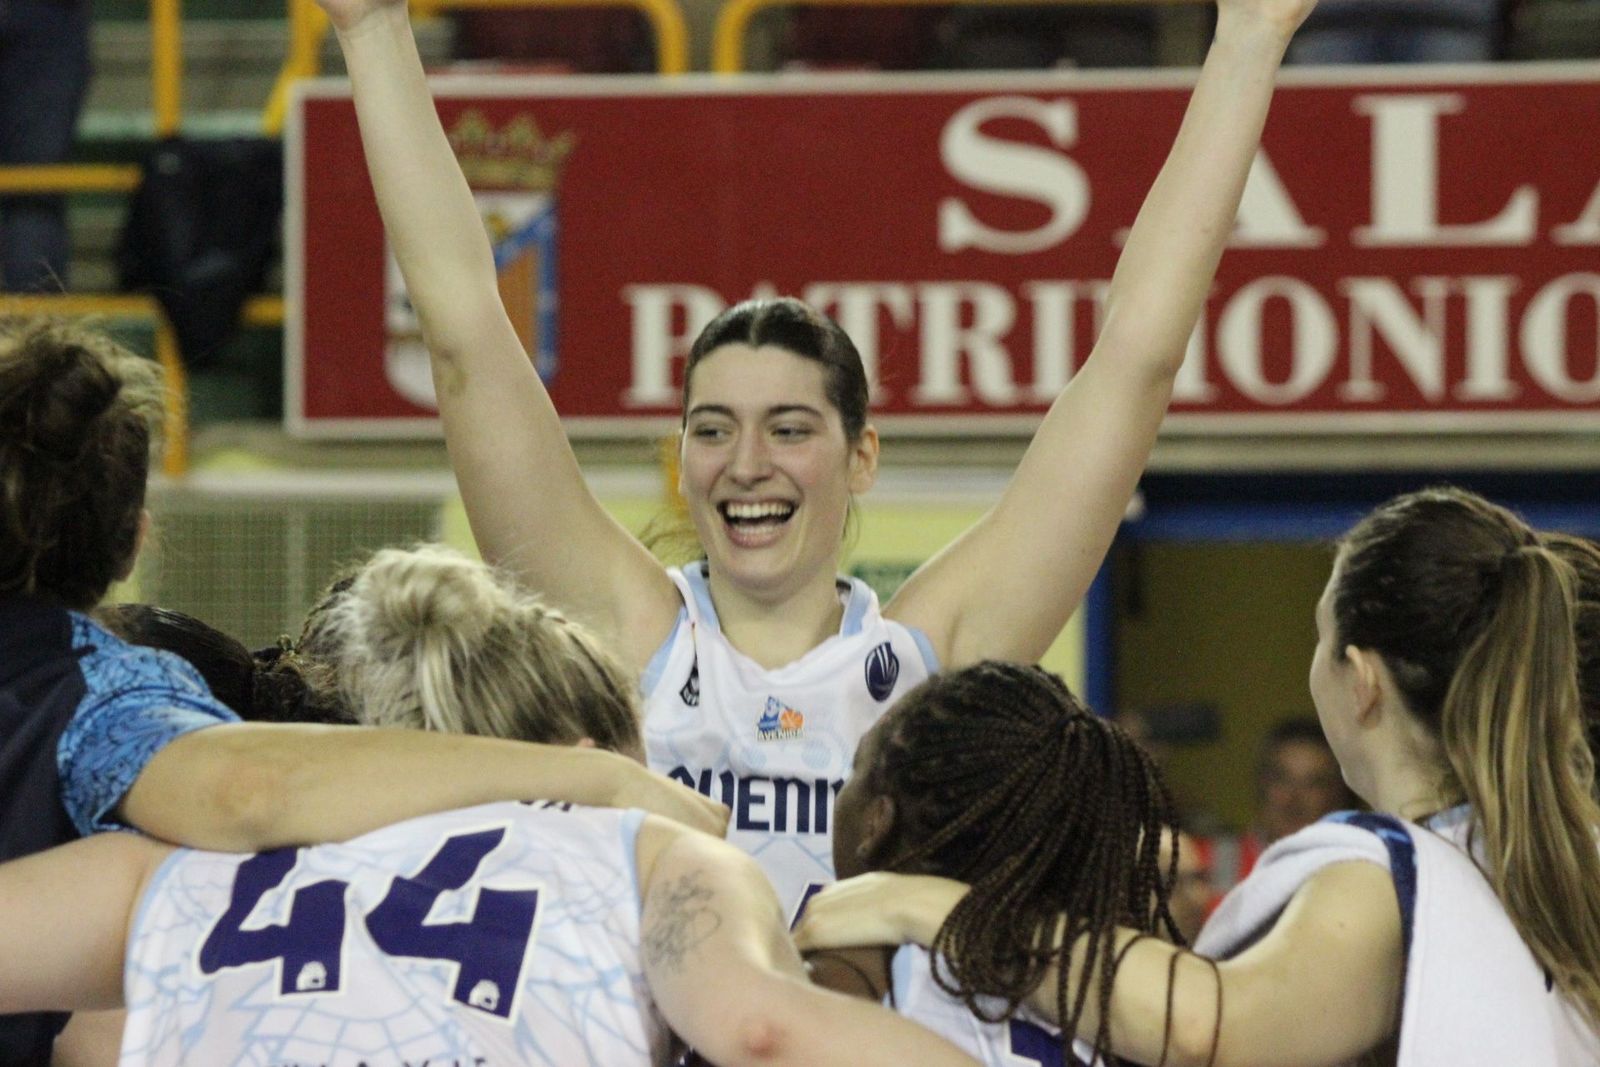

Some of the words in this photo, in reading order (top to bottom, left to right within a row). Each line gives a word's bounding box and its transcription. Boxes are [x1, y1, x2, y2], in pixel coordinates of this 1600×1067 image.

[939, 93, 1600, 254] SL
[621, 272, 1600, 408] PTRIONIO
[199, 824, 541, 1019] 44
